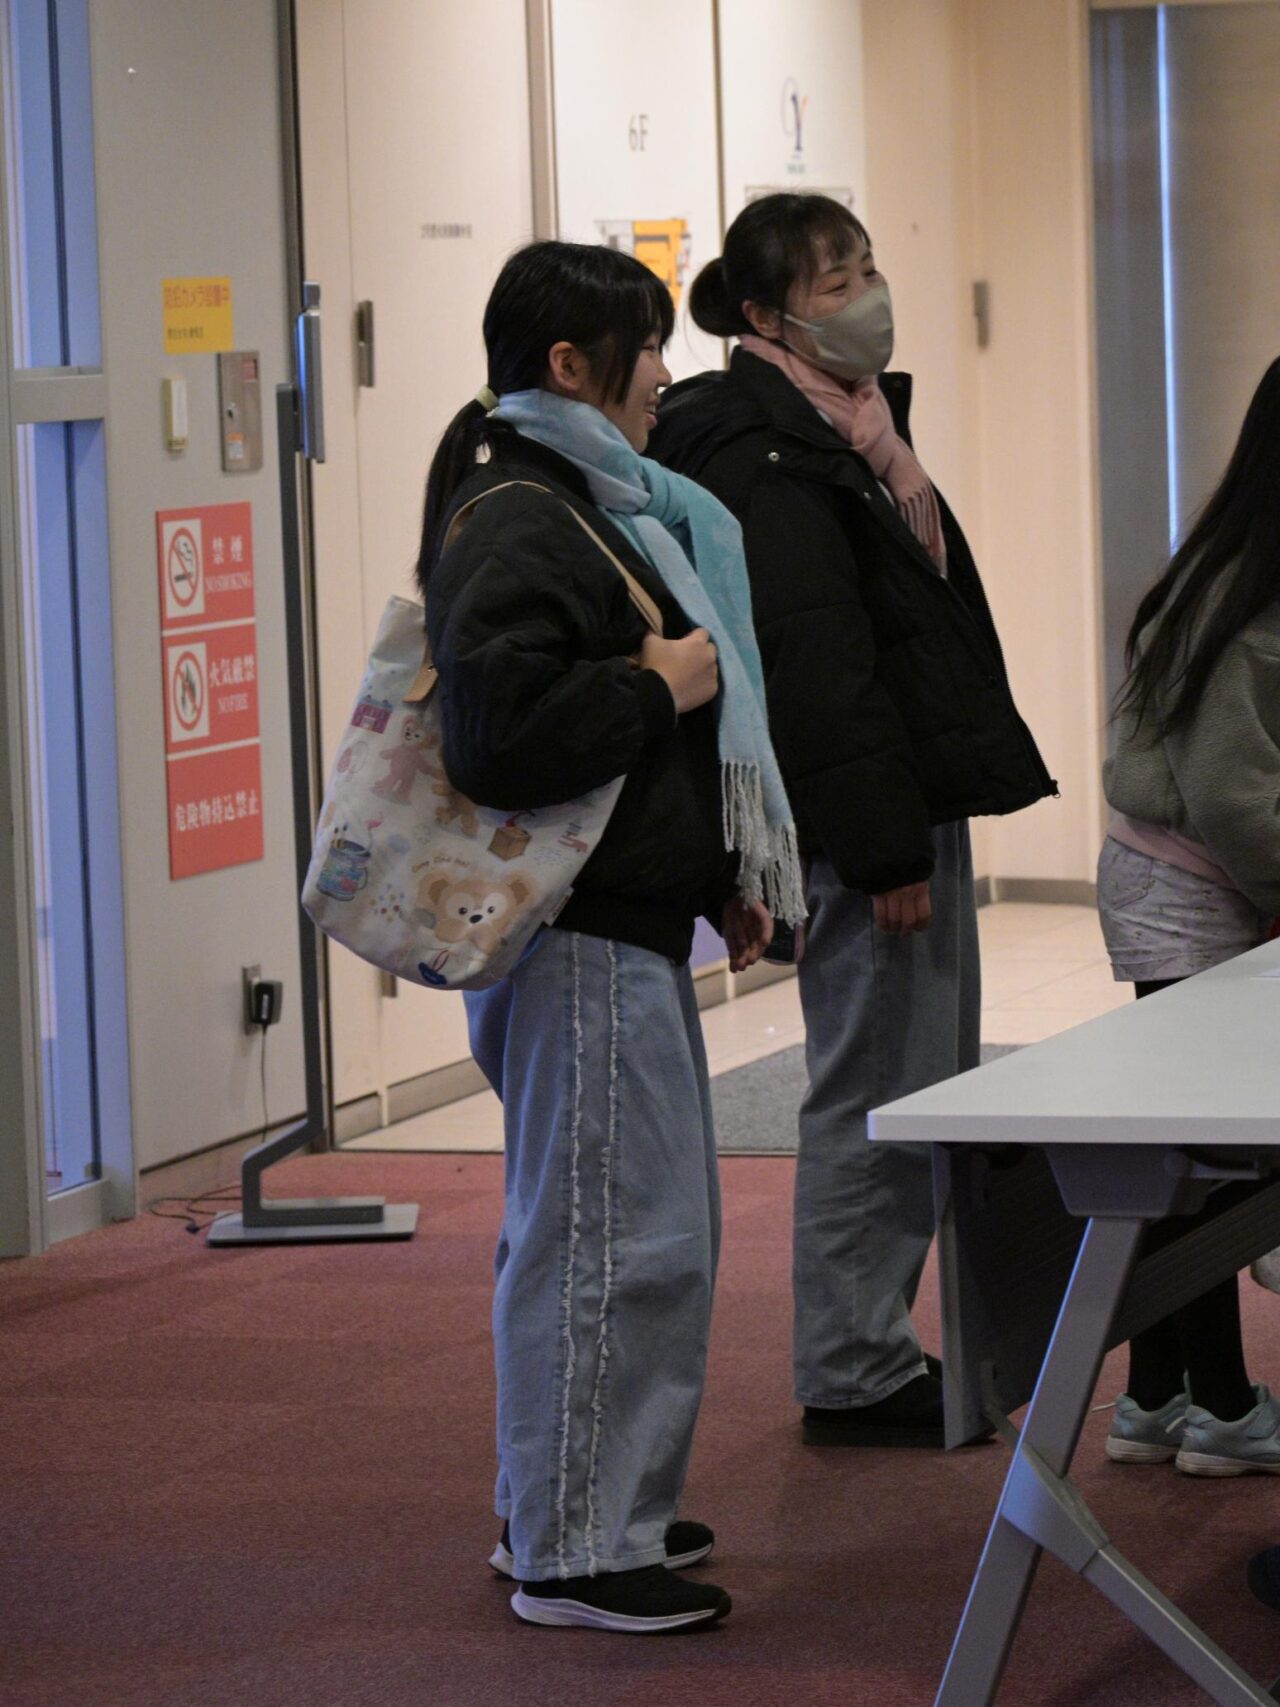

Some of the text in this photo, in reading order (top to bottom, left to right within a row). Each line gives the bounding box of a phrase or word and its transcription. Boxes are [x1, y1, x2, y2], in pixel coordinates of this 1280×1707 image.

[628, 113, 649, 152] 6F
[211, 534, 244, 565] 禁煙
[210, 654, 255, 687] 火気厳禁
[175, 788, 258, 831] 危険物持込禁止
